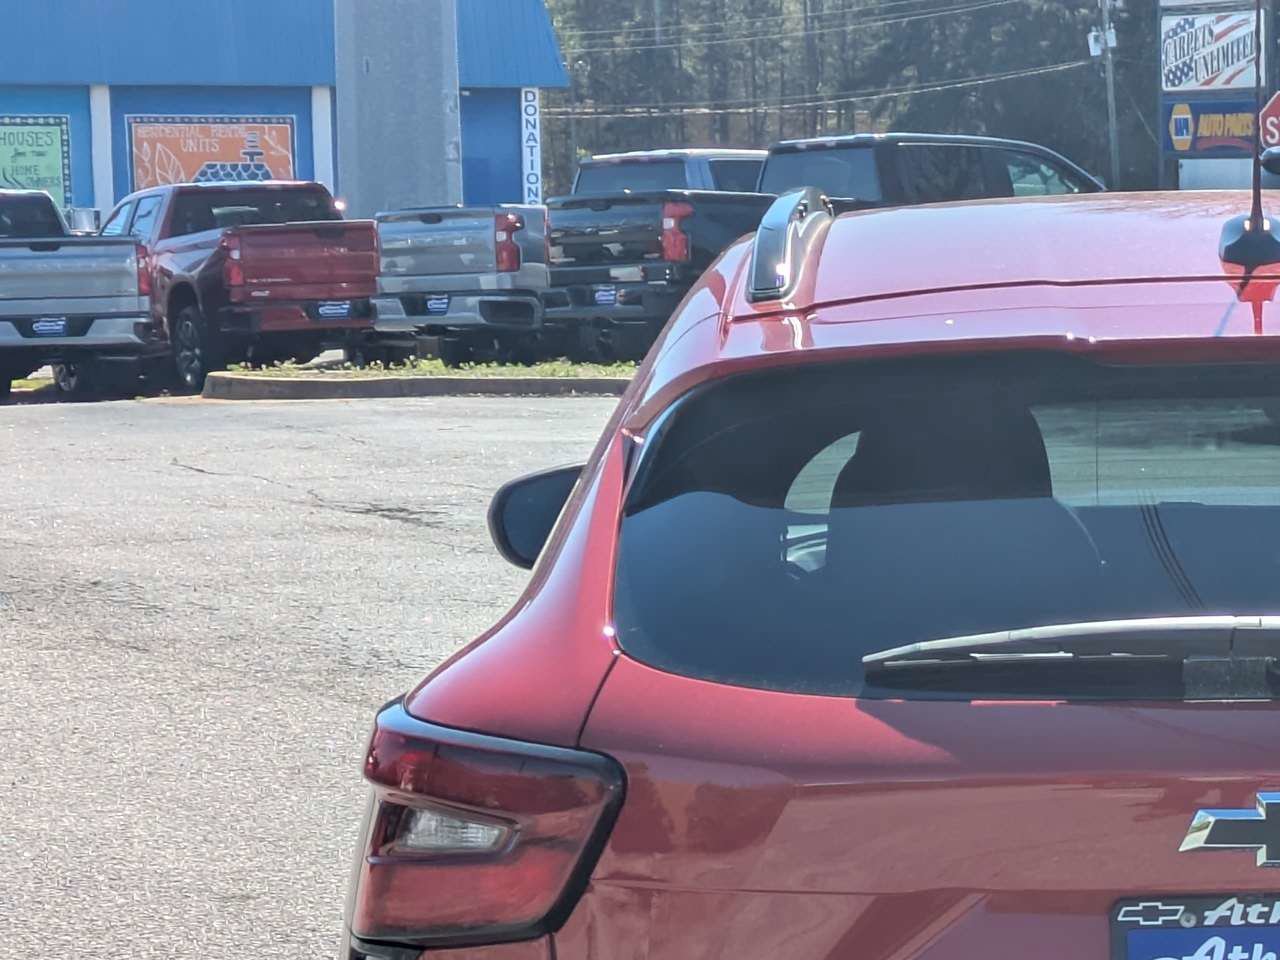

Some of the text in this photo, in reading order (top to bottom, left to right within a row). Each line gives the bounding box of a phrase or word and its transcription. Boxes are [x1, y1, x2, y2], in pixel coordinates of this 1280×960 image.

[1164, 20, 1216, 68] CARPETS
[1197, 114, 1224, 136] AUTO
[180, 138, 220, 153] UNITS
